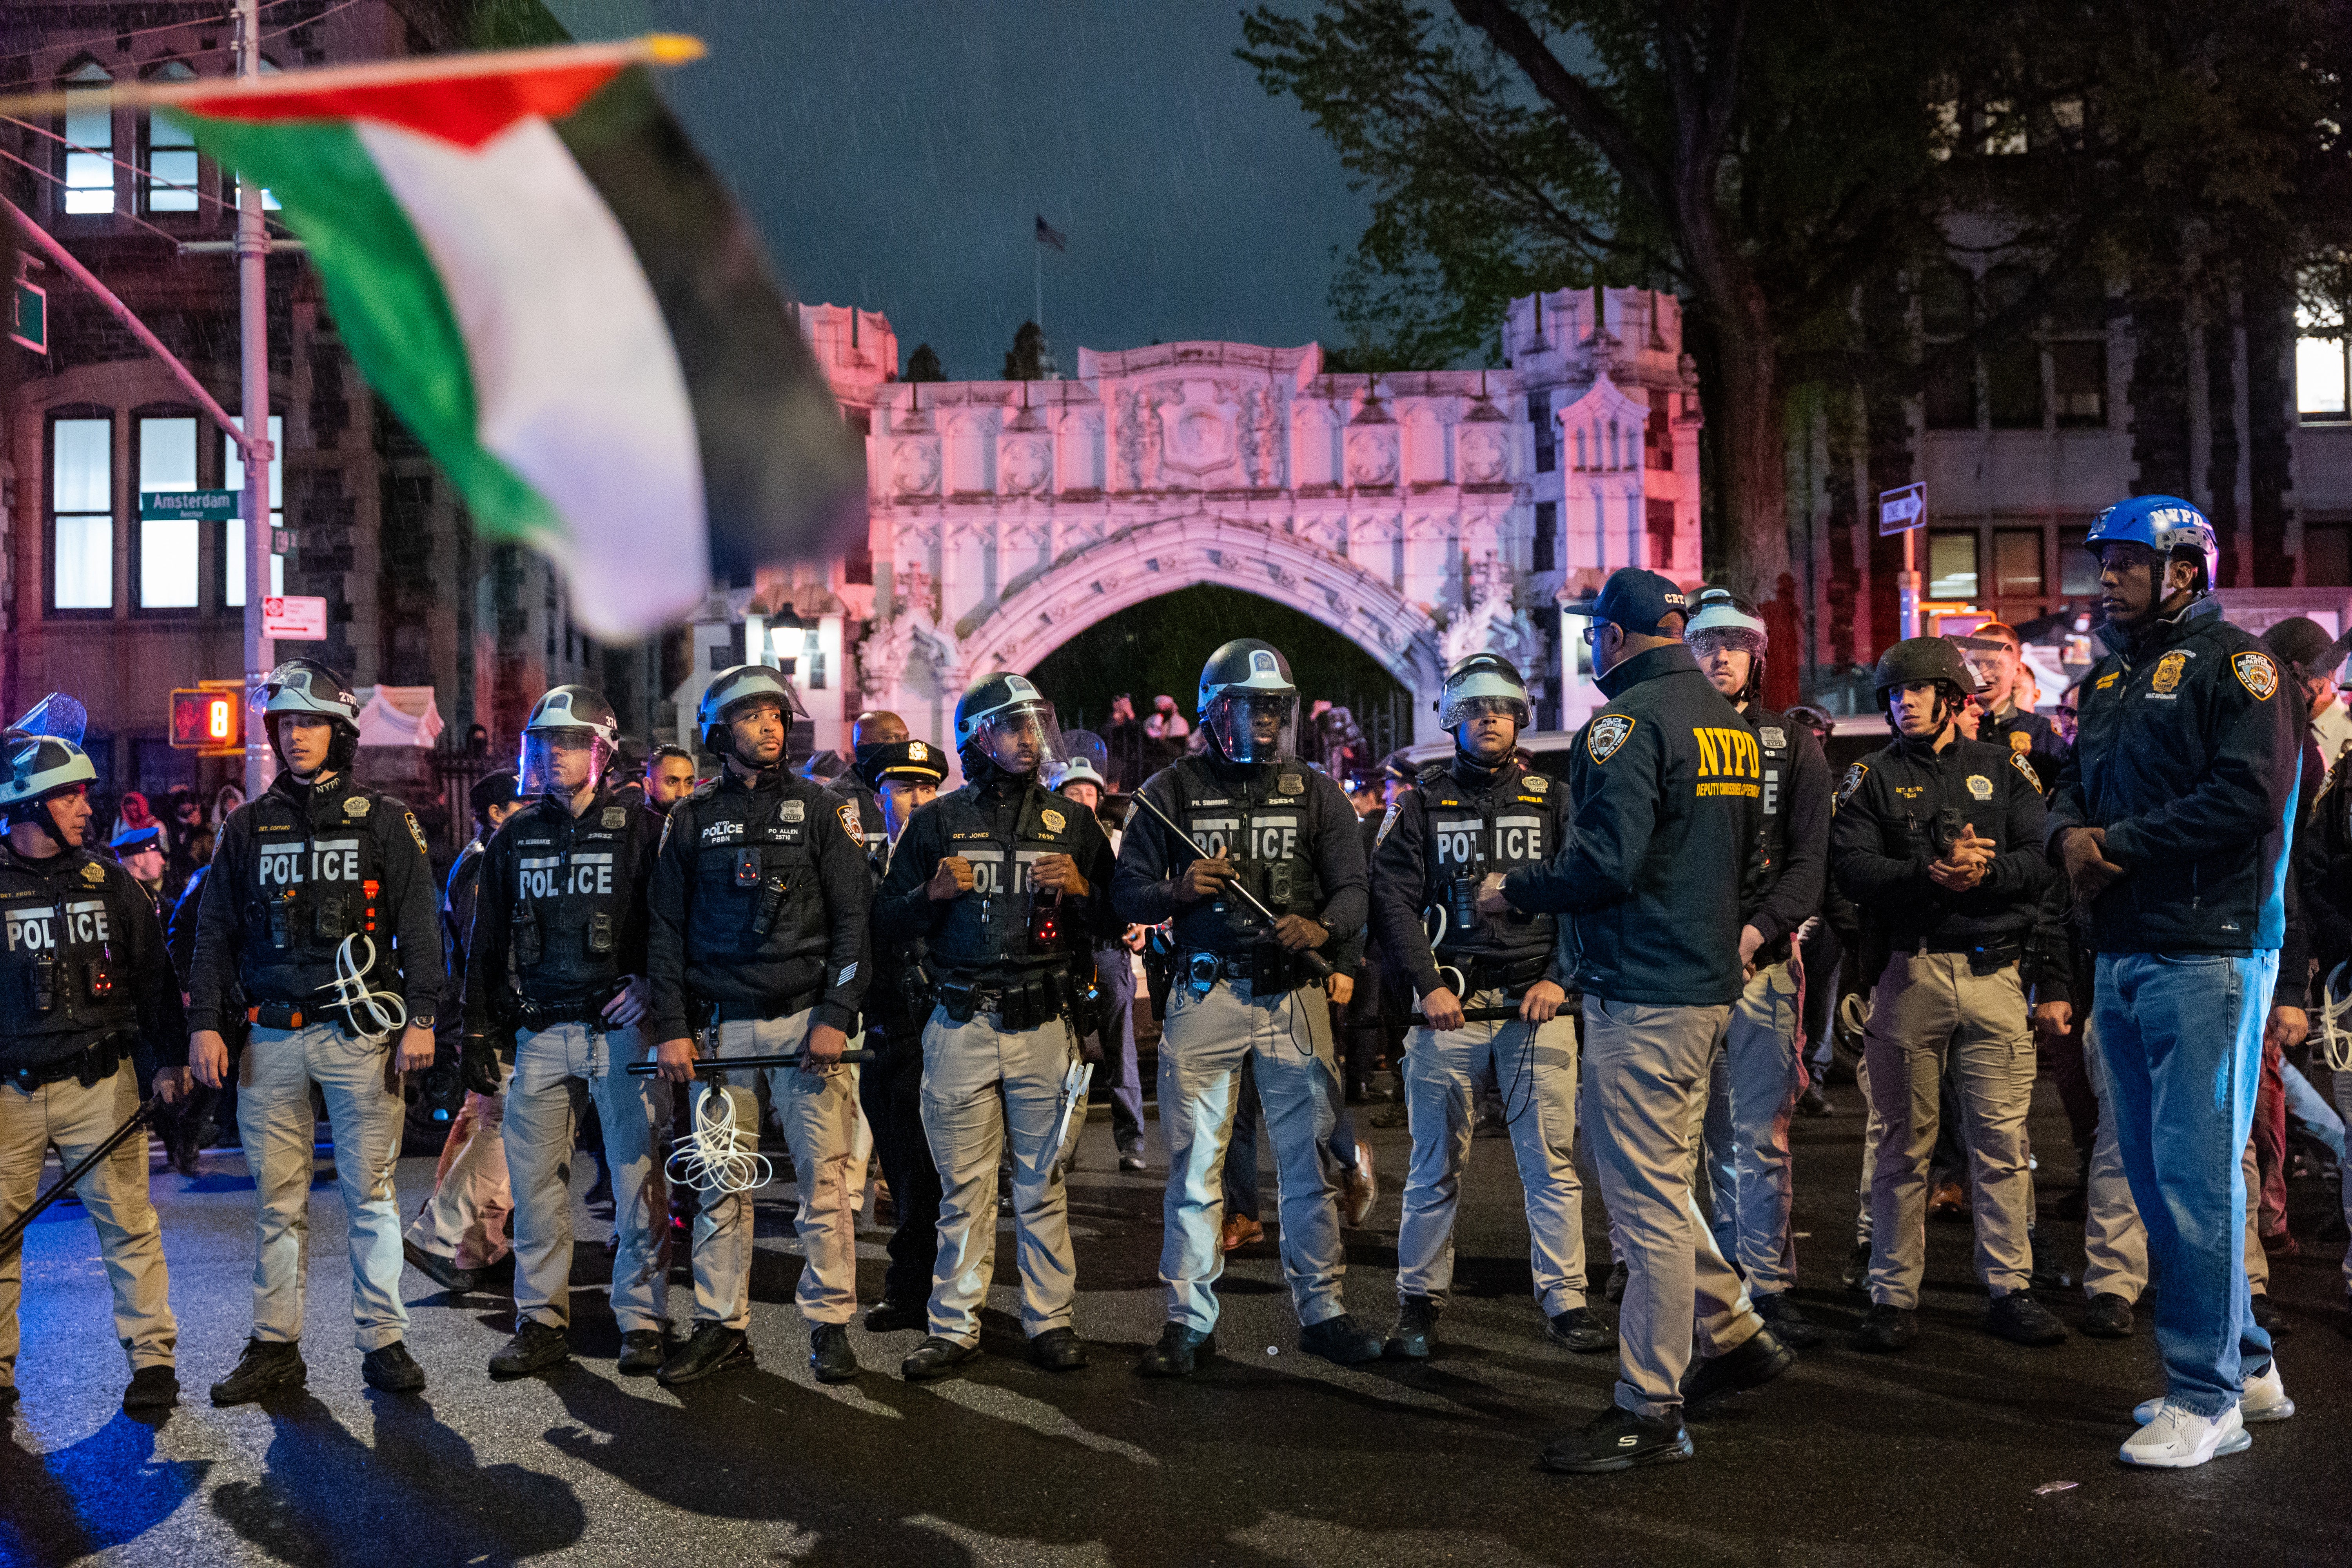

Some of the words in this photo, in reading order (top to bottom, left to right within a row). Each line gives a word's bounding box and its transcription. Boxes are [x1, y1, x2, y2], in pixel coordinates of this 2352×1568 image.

[153, 493, 230, 509] Amsterdam
[2148, 508, 2203, 528] NYPD
[1664, 593, 1685, 604] CRT
[2238, 659, 2274, 673] DEPARTMENT
[2245, 654, 2268, 664] POLICE
[2239, 671, 2250, 682] CITY
[211, 701, 228, 737] 8
[1604, 746, 1615, 757] NEW
[1613, 732, 1627, 746] YORK
[1693, 728, 1760, 779] NYPD
[1696, 782, 1719, 797] DEPUTY
[702, 824, 744, 838] POLICE
[712, 835, 730, 844] PBBN
[1437, 828, 1541, 864] POLICE
[260, 851, 359, 886] POLICE
[973, 862, 1057, 894] OLI
[520, 866, 612, 900] POLICE
[6, 912, 109, 952] POLICE
